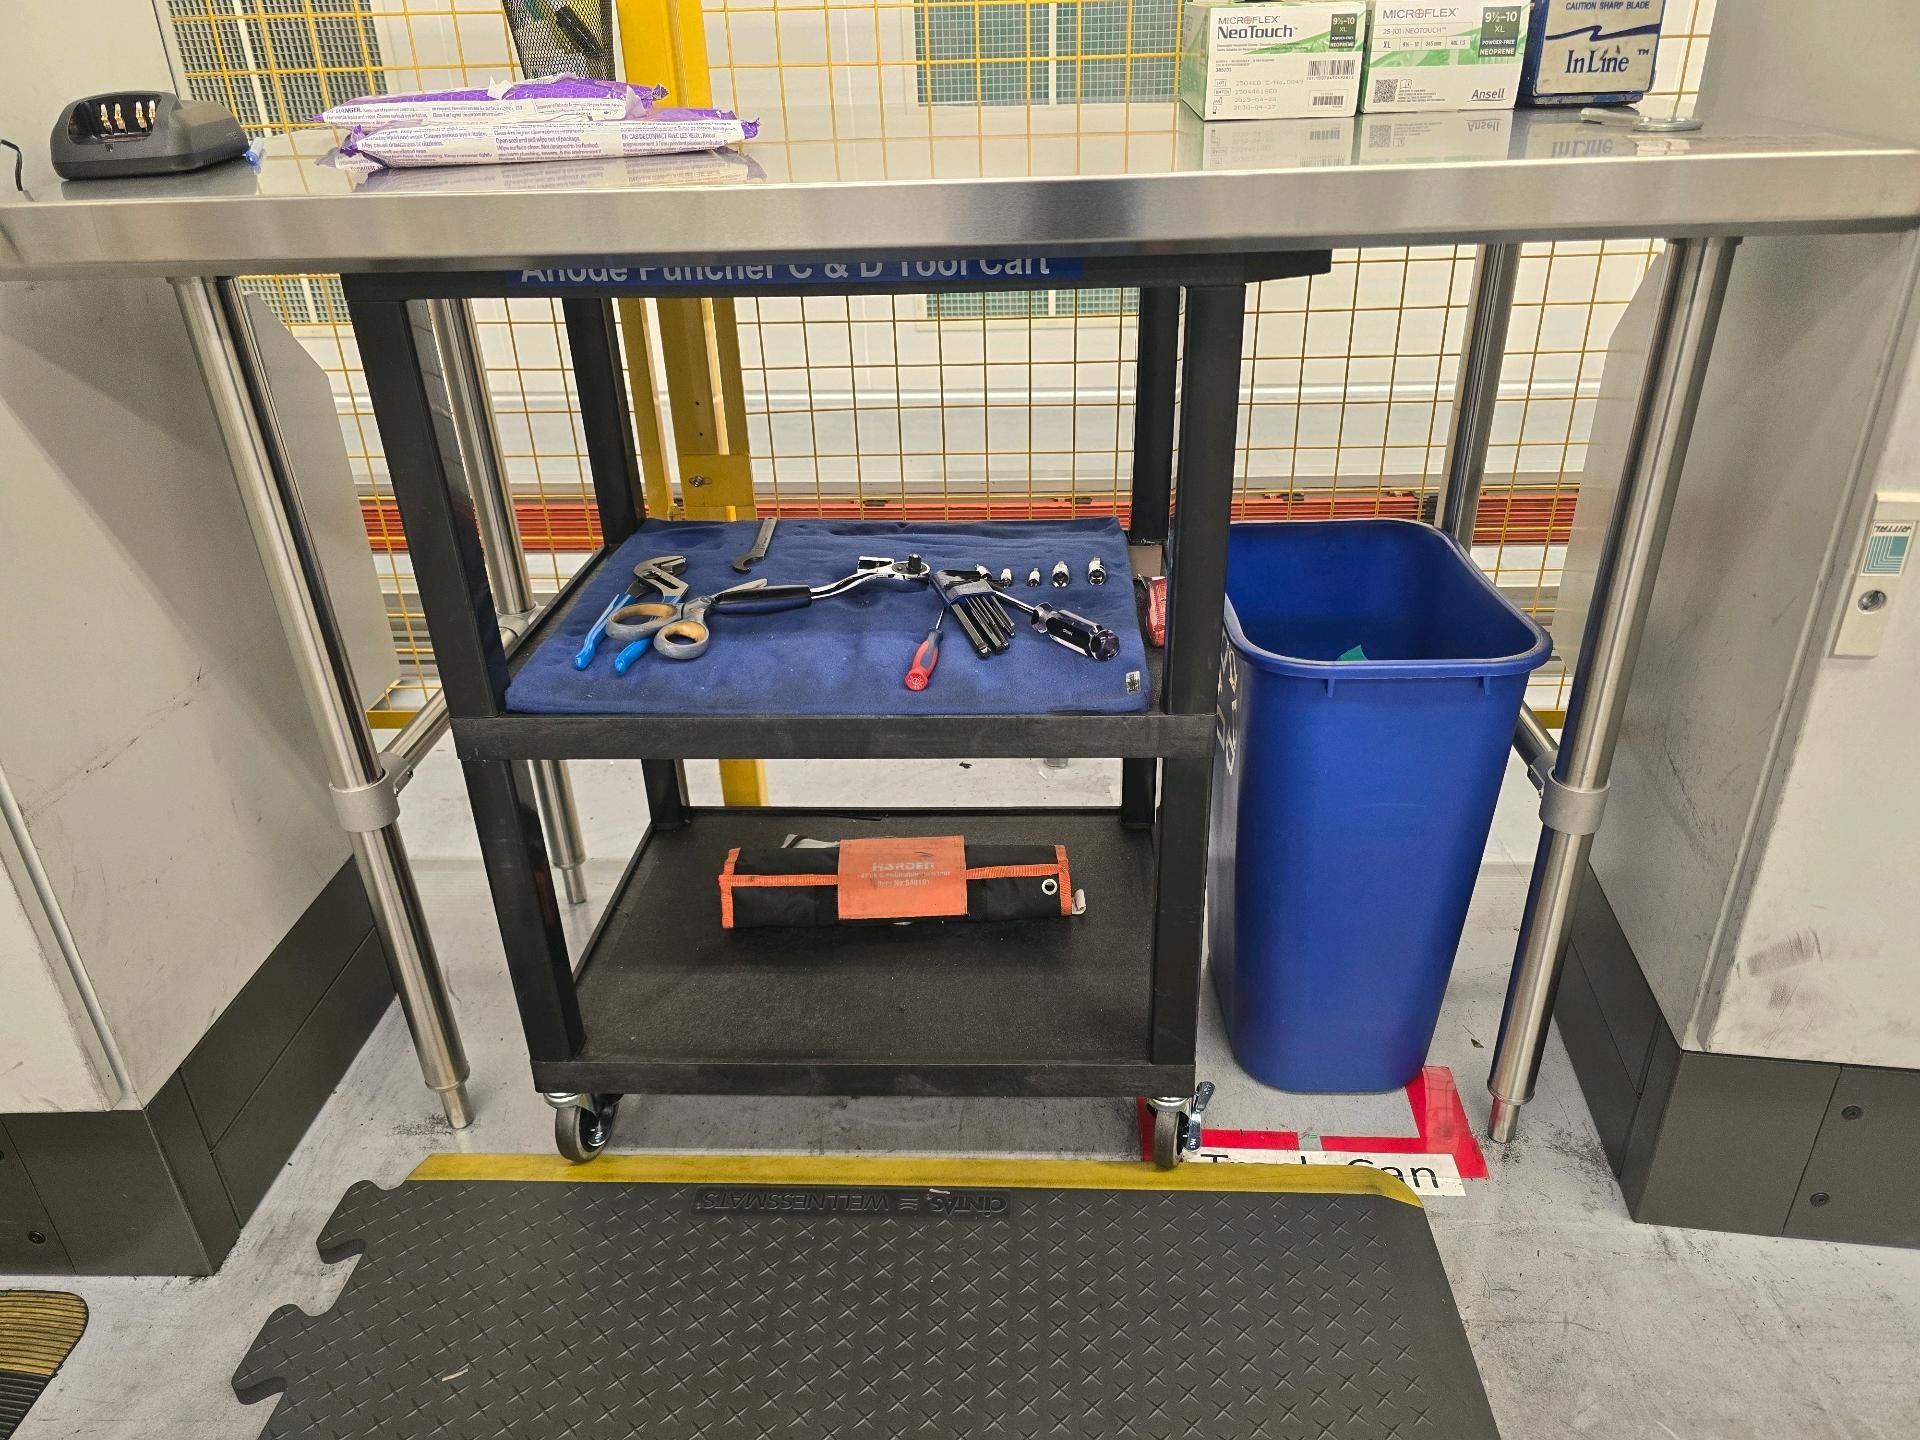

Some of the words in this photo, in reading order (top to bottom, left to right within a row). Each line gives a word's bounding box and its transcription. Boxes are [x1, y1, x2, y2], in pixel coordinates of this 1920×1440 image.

[1566, 2, 1597, 10] CAUTION
[1599, 1, 1624, 10] SHARP
[1626, 1, 1650, 9] BLADE
[1382, 8, 1458, 19] MICROFLEX
[1218, 15, 1279, 25] MICROFLEX
[1479, 48, 1515, 56] NEOPRENE
[1471, 88, 1505, 100] Ansell
[824, 262, 848, 279] &
